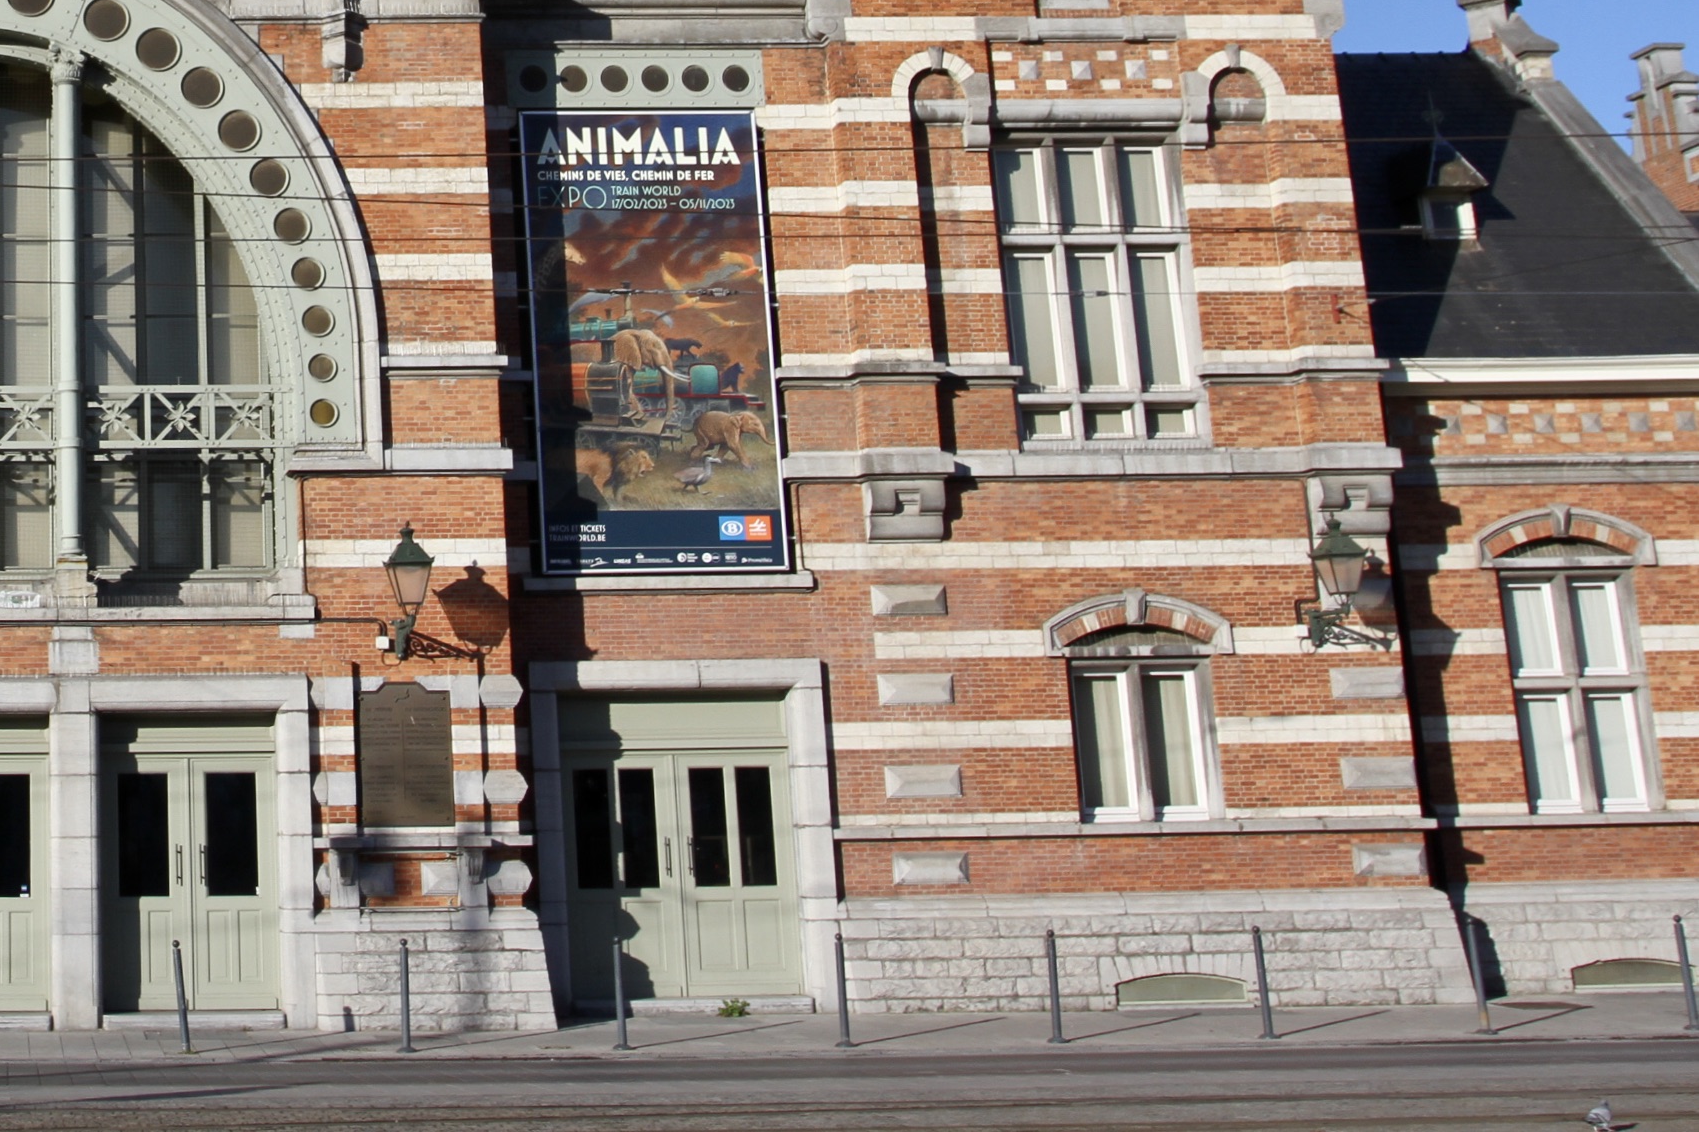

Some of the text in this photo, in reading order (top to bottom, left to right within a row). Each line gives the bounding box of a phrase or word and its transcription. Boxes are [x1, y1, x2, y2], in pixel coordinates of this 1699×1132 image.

[537, 127, 742, 165] ANIMALIA
[537, 170, 714, 182] CHEMINS DE VIES, CHEMIN DE FER
[611, 185, 682, 196] TRAIN WORLD
[537, 185, 607, 209] EXPO
[611, 198, 667, 210] 17/02/2023
[678, 198, 735, 210] 05/11/2023
[549, 524, 570, 532] INFOS
[580, 524, 606, 532] TICKETS
[549, 534, 606, 542] TRAINWORLD.BE
